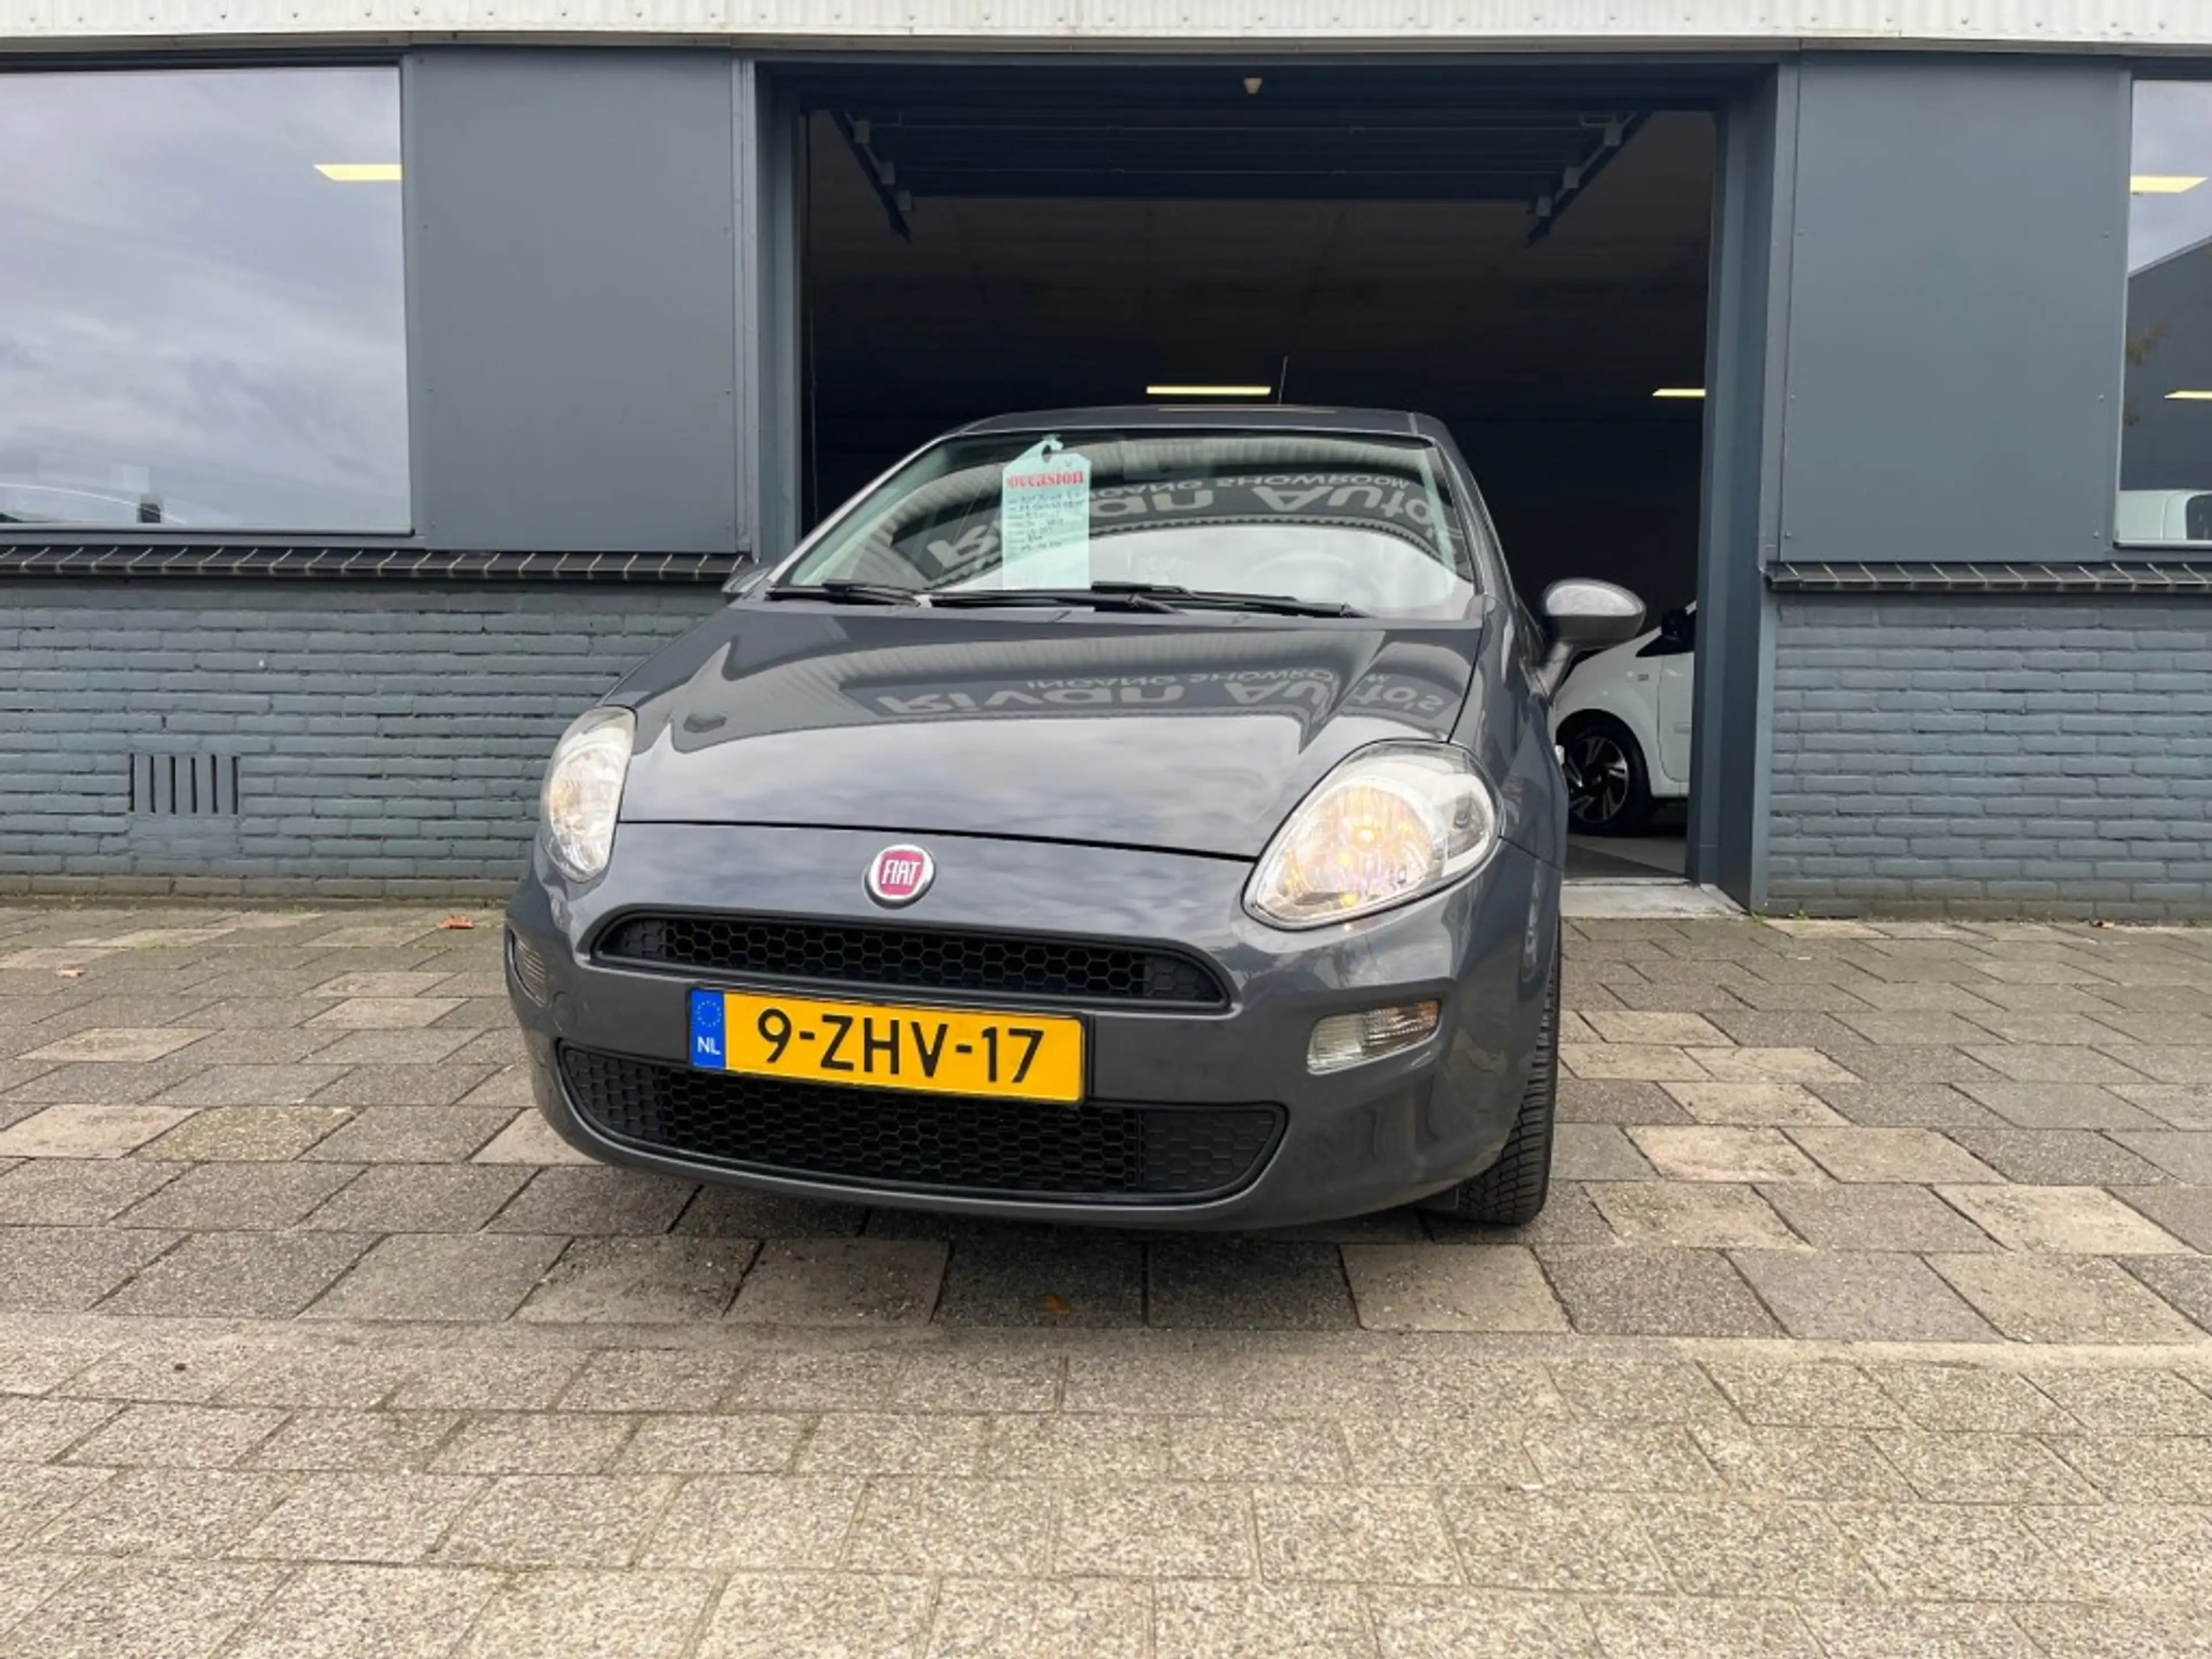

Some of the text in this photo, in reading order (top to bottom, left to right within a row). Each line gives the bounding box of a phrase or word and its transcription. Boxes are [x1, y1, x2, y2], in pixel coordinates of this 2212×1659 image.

[881, 859, 921, 885] FIAT
[697, 1036, 722, 1055] NL
[757, 1007, 1045, 1084] 9-ZHV-17
